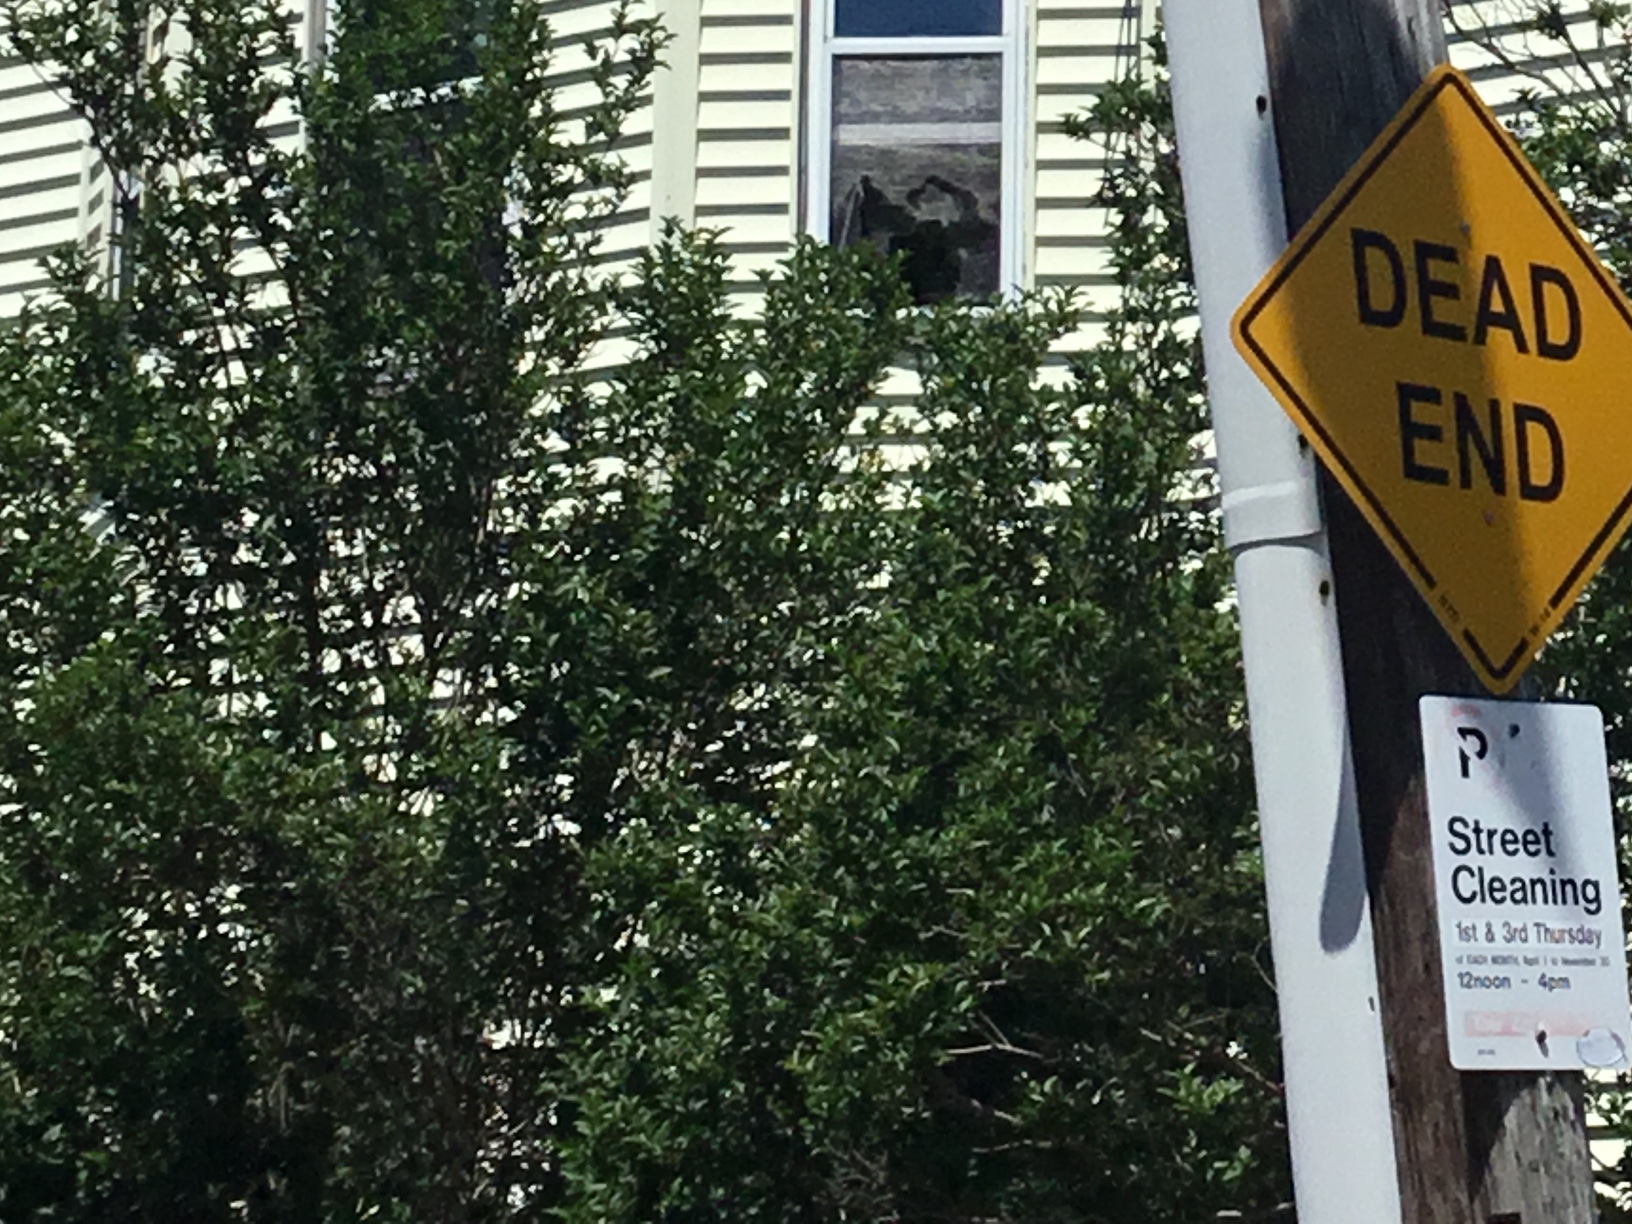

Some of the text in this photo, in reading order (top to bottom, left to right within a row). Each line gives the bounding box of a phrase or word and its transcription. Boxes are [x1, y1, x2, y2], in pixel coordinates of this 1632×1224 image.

[1350, 228, 1582, 361] DEAD
[1396, 381, 1565, 503] END
[1448, 816, 1556, 857] Street
[1451, 864, 1602, 916] Cleaning
[1455, 921, 1602, 949] 1st & 3rd Thursday
[1457, 971, 1511, 989] 12noon
[1538, 972, 1571, 992] 4pm
